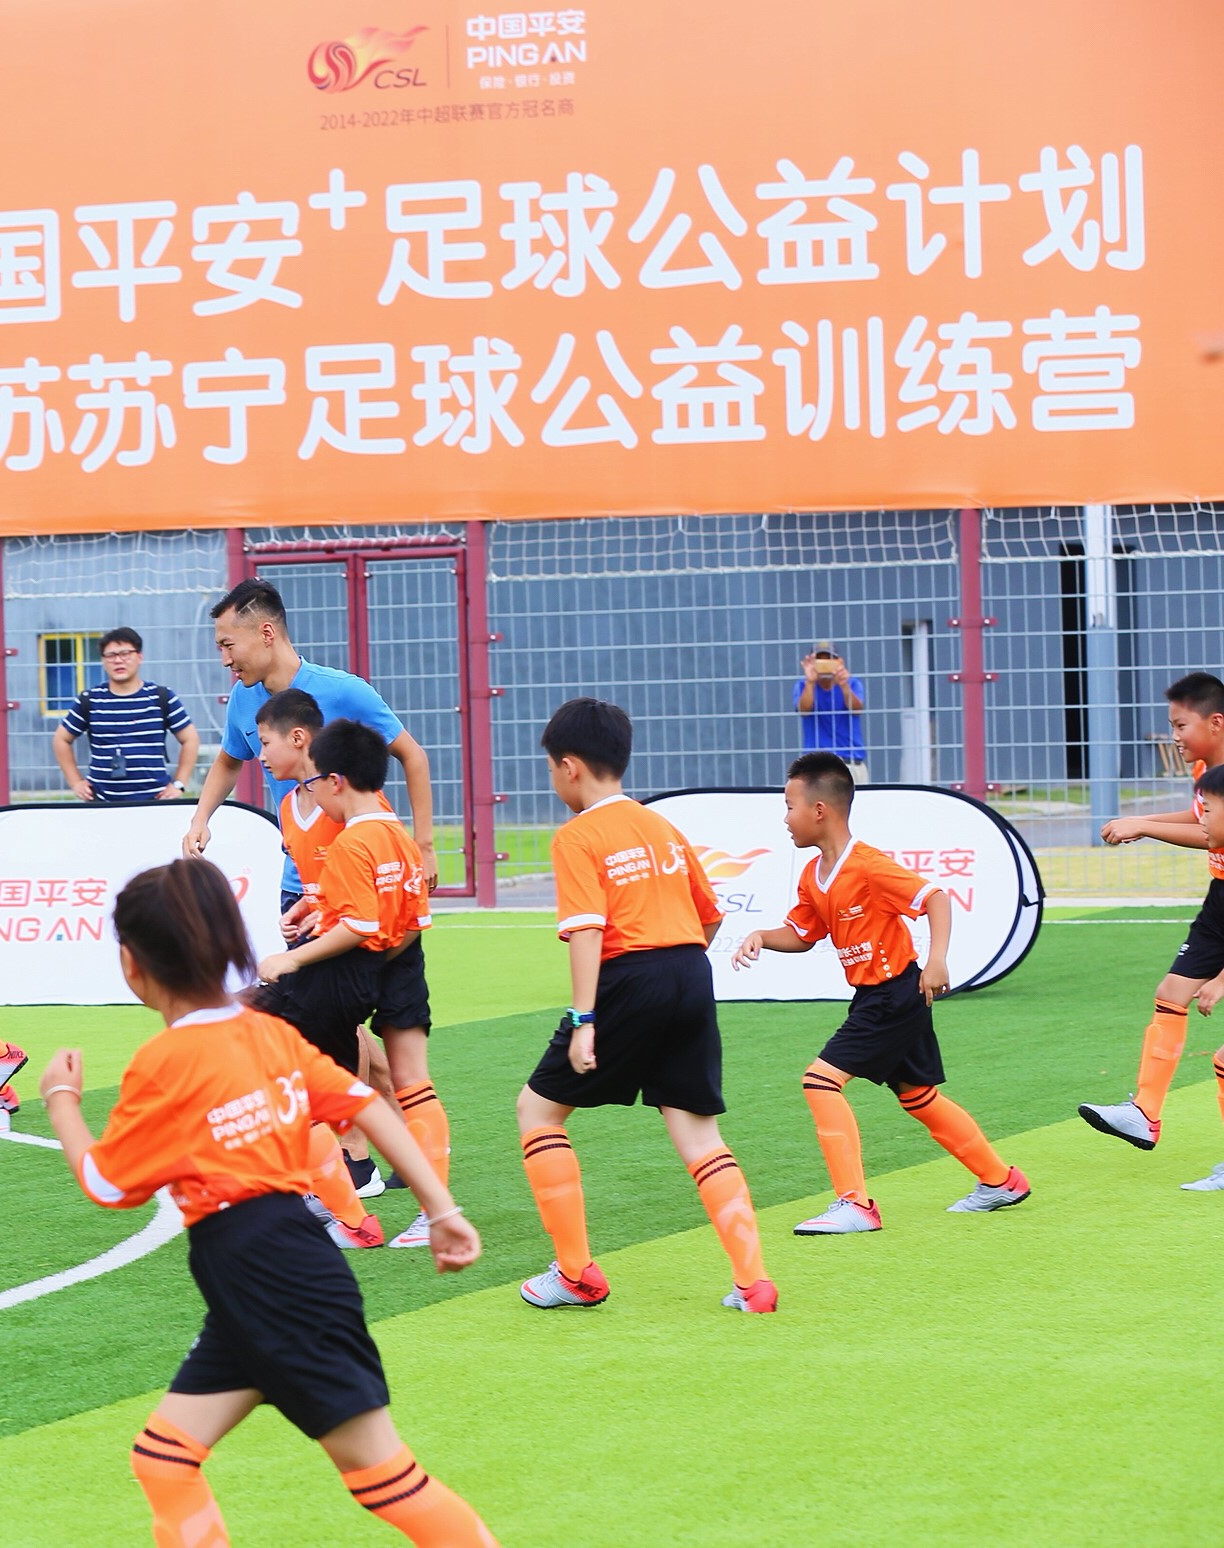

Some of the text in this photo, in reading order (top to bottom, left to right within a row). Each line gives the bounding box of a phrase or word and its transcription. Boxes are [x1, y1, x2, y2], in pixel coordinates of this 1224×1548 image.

[466, 9, 586, 41] 中国平安
[373, 68, 427, 90] CSL
[881, 848, 976, 878] 平安
